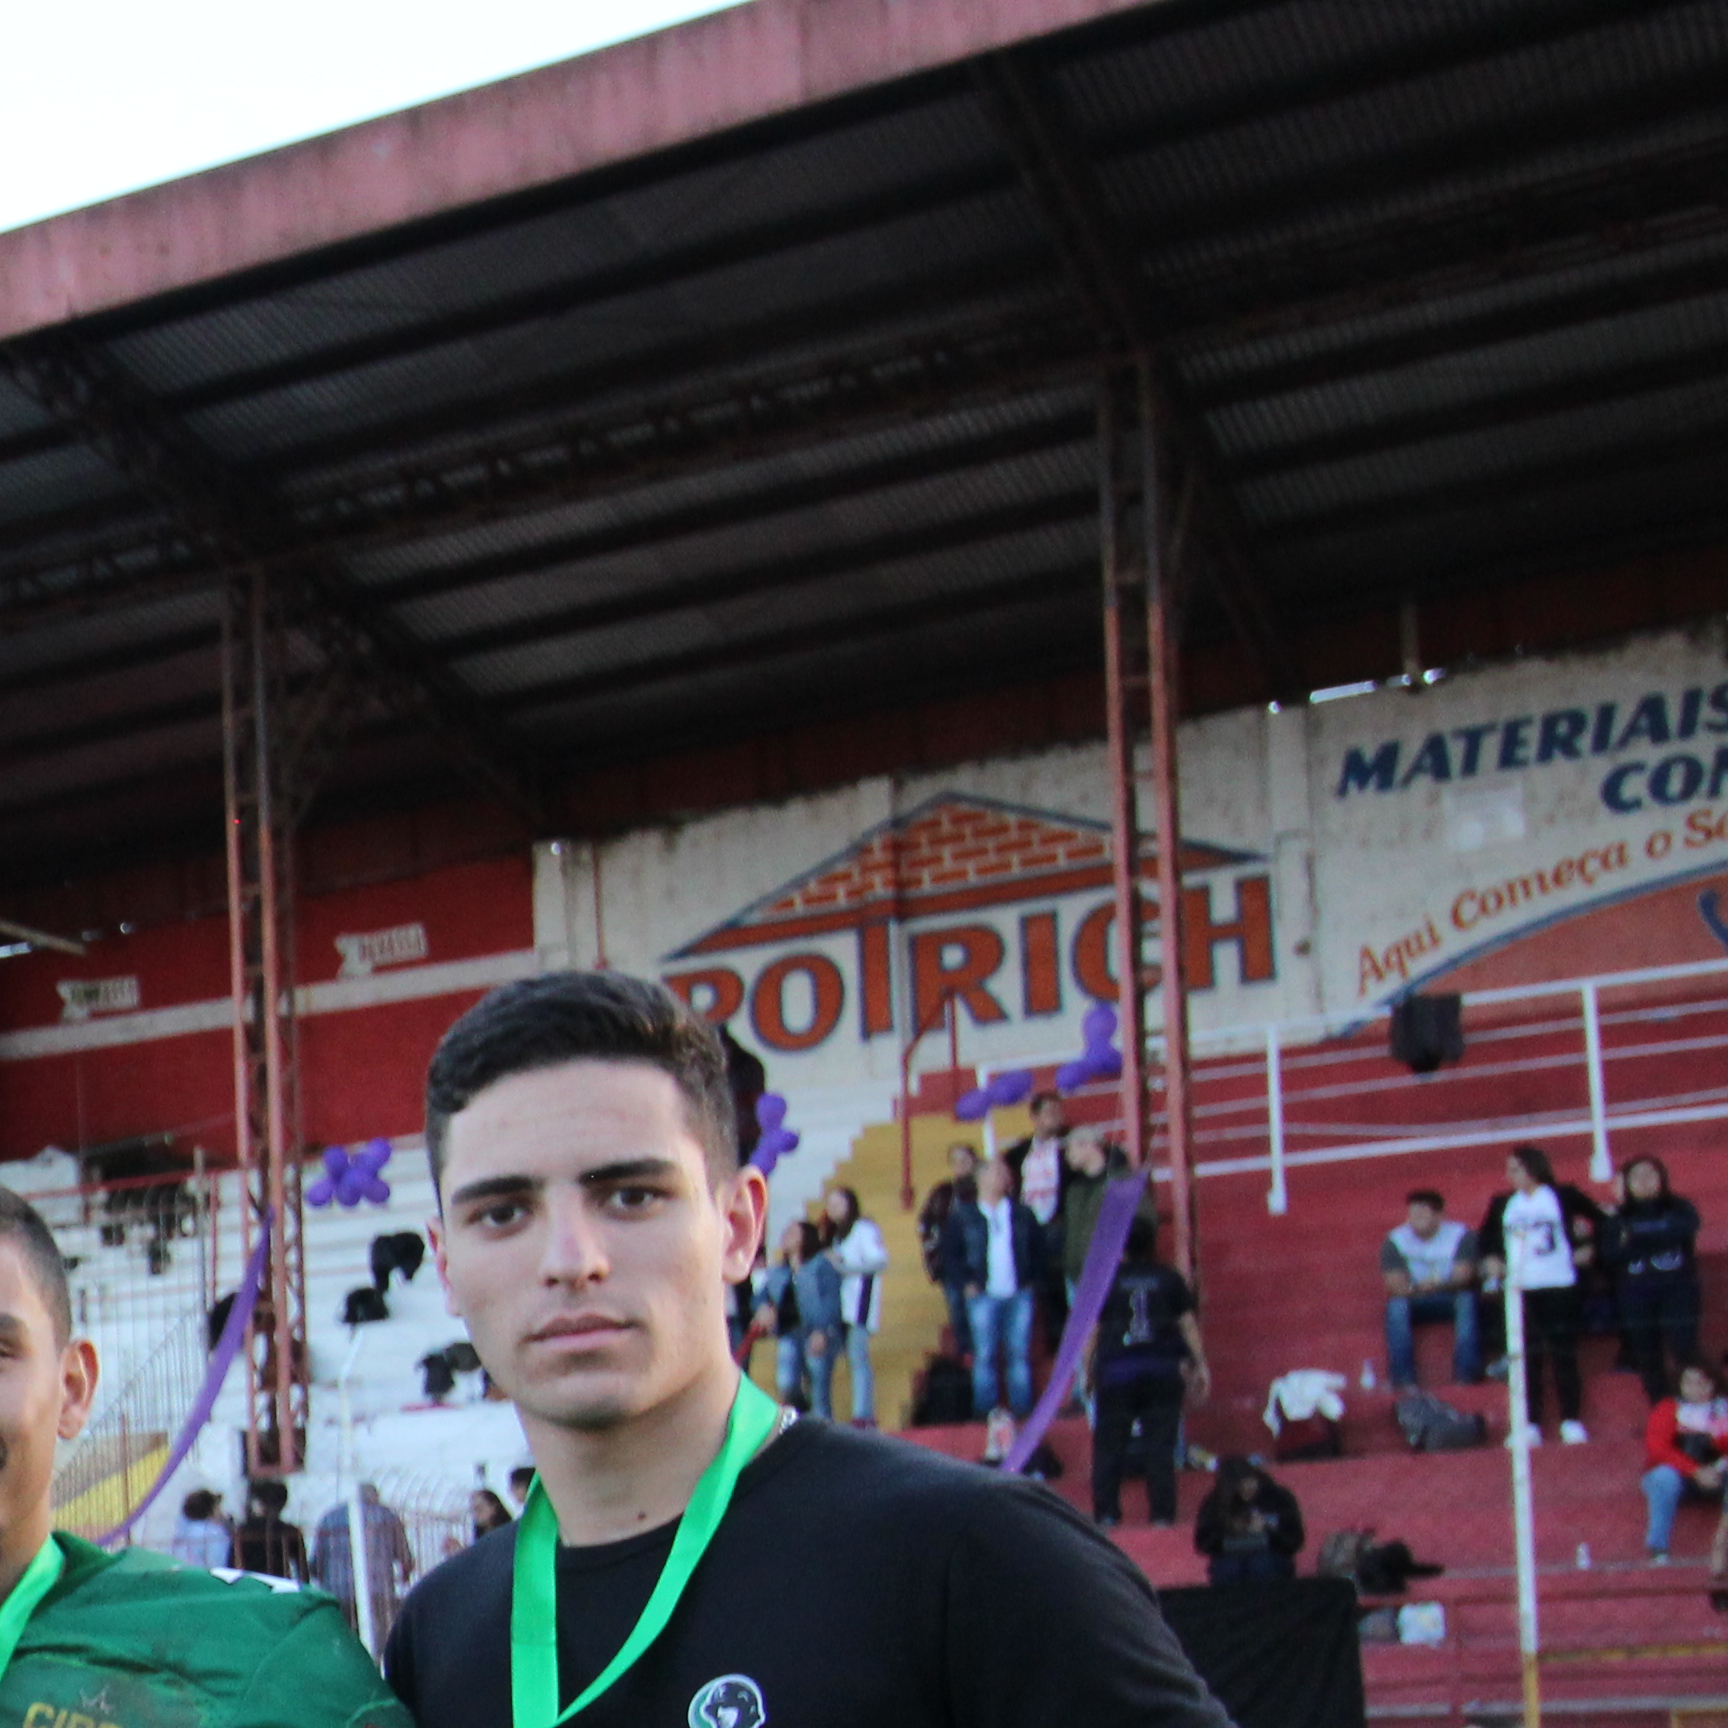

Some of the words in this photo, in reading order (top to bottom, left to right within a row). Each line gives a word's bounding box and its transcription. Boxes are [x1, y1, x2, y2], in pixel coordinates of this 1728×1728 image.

[1356, 918, 1443, 998] Aqui
[1449, 839, 1629, 933] Começa
[1645, 827, 1673, 860] o
